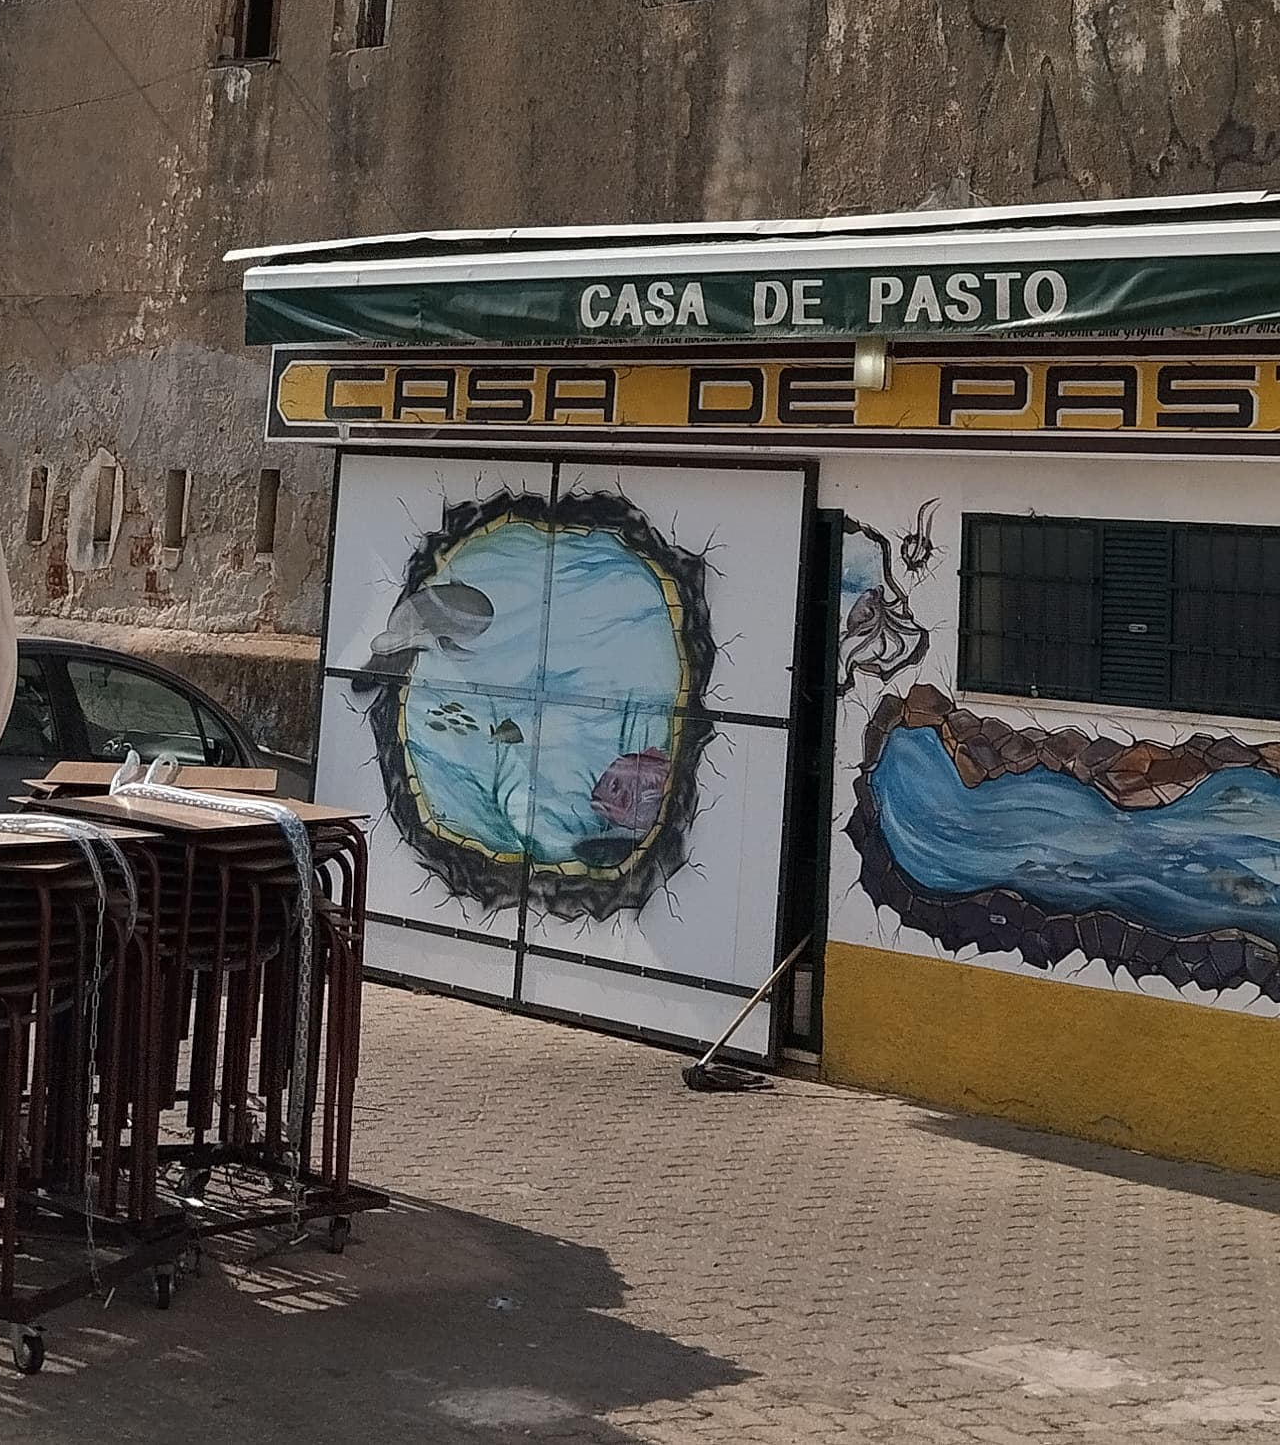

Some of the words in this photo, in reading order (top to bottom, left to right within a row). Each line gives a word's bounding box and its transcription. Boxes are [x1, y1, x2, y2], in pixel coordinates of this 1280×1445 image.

[580, 281, 709, 328] CASA
[753, 279, 823, 326] DE
[868, 270, 1068, 324] PASTO
[324, 366, 617, 424] CASA
[688, 366, 856, 425] DE
